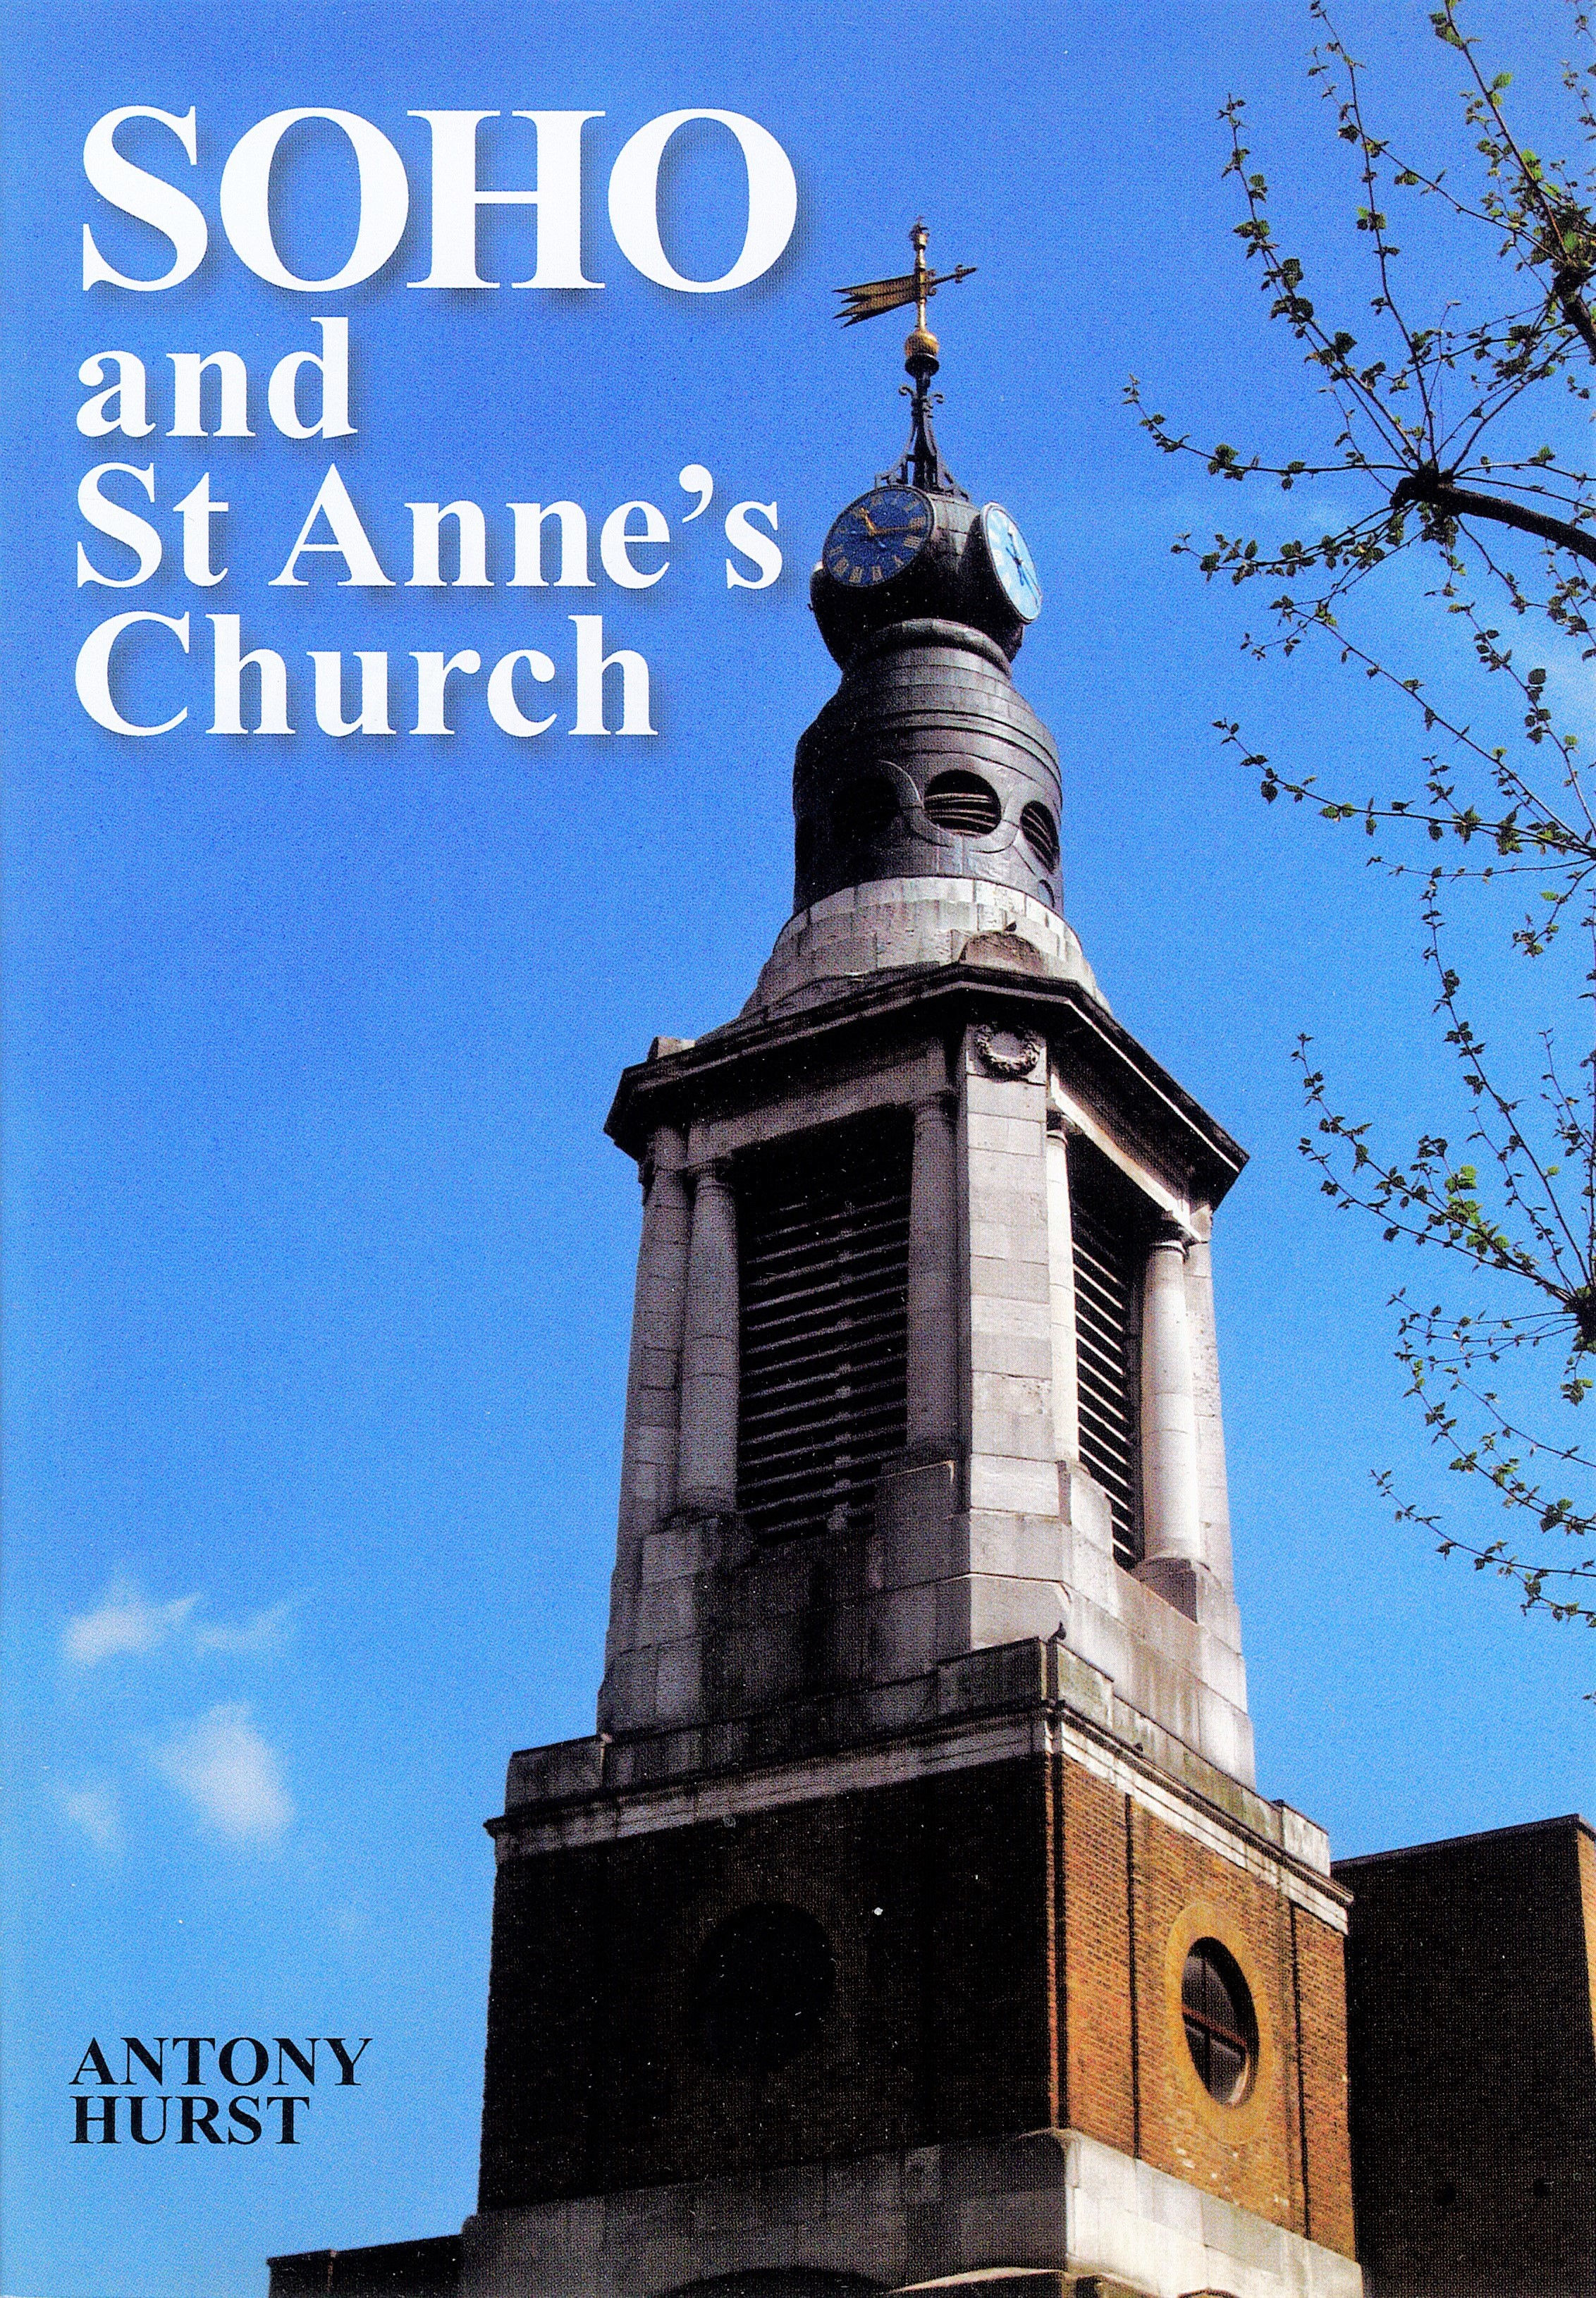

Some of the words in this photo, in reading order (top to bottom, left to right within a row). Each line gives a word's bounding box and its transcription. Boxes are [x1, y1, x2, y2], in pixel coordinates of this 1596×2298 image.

[82, 105, 798, 293] SOHO
[75, 317, 358, 439] and
[76, 462, 229, 588] St
[268, 463, 783, 589] Anne’s
[75, 610, 658, 737] Church
[68, 2036, 373, 2087] ANTONY
[70, 2095, 310, 2145] HURST
